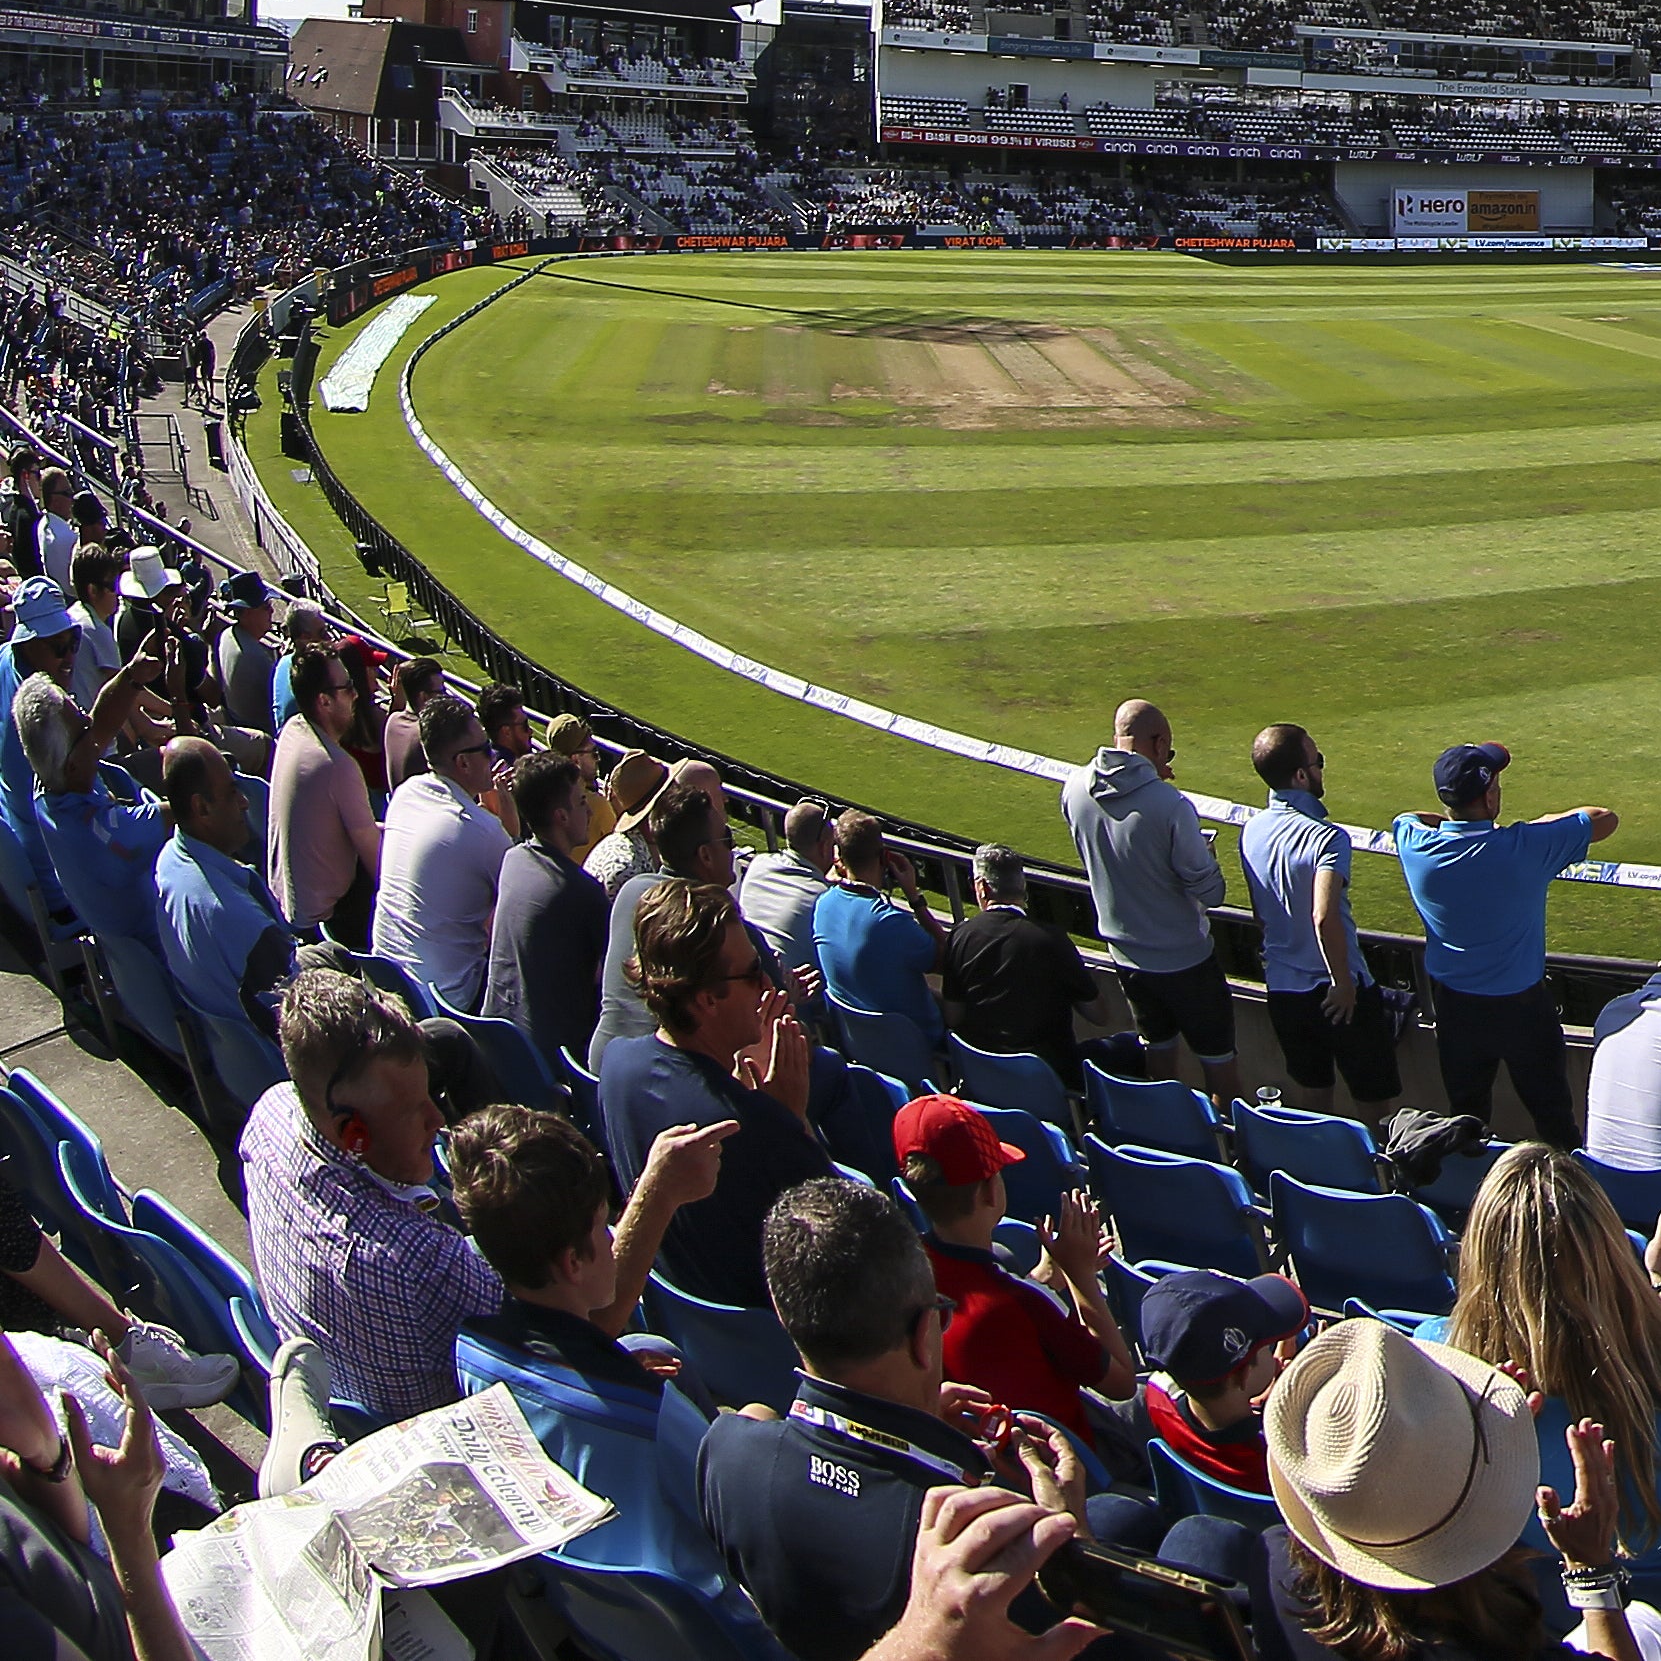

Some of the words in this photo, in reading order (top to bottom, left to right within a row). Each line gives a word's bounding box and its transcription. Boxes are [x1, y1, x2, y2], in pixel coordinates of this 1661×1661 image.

[1436, 82, 1455, 93] The
[1457, 83, 1498, 95] Emerald
[1500, 84, 1527, 96] Stand
[1036, 137, 1077, 149] VIRUSES
[1104, 142, 1136, 153] cinch
[1146, 143, 1178, 154] cinch
[1187, 145, 1219, 157] cinch
[1229, 146, 1260, 158] cinch
[1270, 148, 1301, 159] cinch
[1470, 201, 1537, 216] amazon.in
[677, 236, 744, 248] CHETESHWAR
[748, 236, 788, 247] PUJARA
[944, 236, 977, 246] VIRAT
[1175, 238, 1250, 248] CHETESHWAR
[1253, 238, 1295, 249] PUJARA
[451, 1414, 492, 1465] Daily
[483, 1463, 549, 1534] Telegraph
[810, 1454, 860, 1490] BOSS
